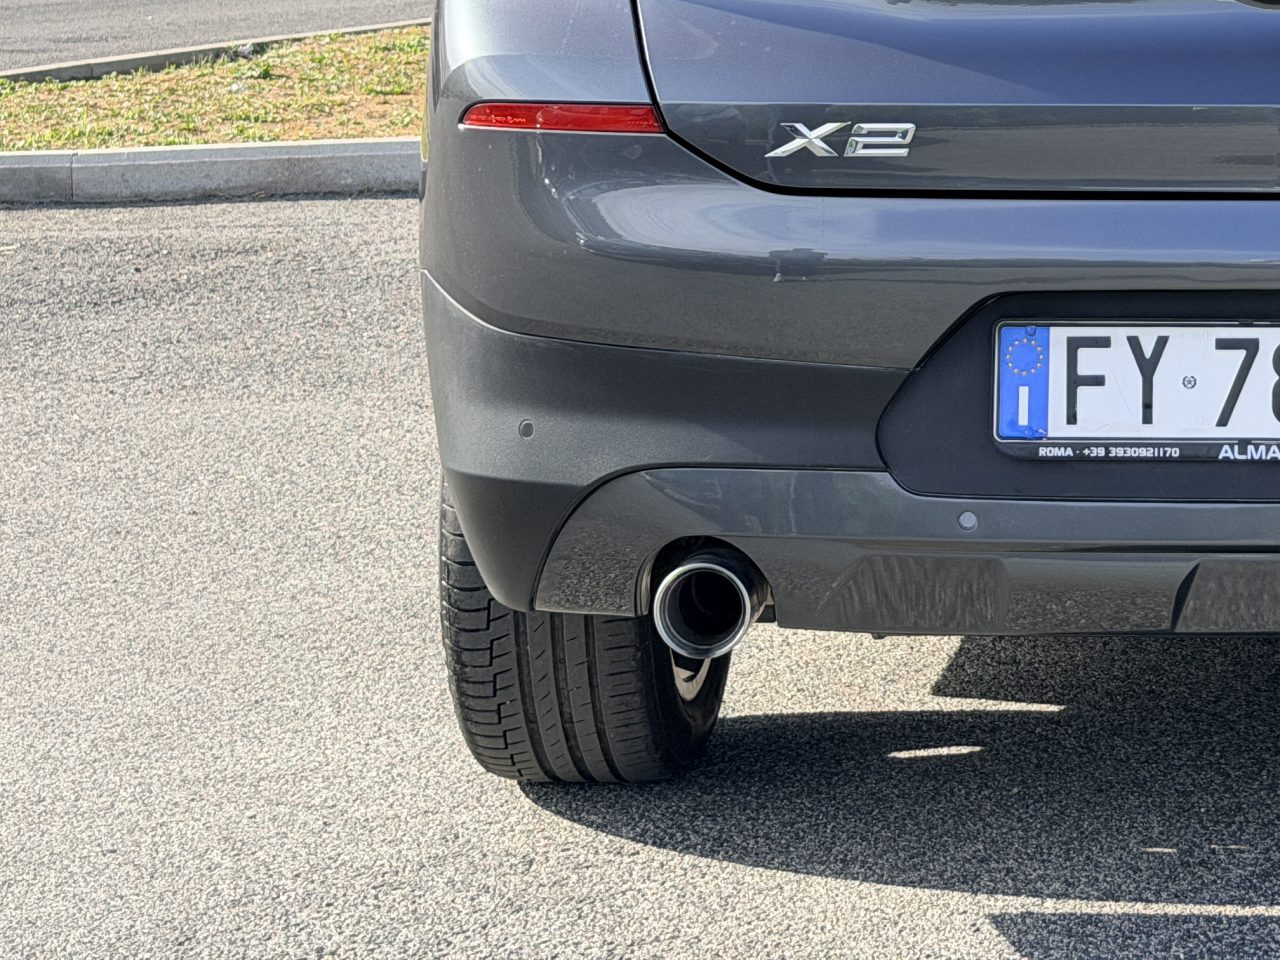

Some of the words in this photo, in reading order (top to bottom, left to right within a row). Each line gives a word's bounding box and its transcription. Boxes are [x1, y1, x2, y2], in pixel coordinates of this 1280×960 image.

[764, 121, 916, 157] X2
[1038, 446, 1074, 457] ROMA
[1082, 446, 1106, 457] +39
[1108, 447, 1180, 458] 3930921170
